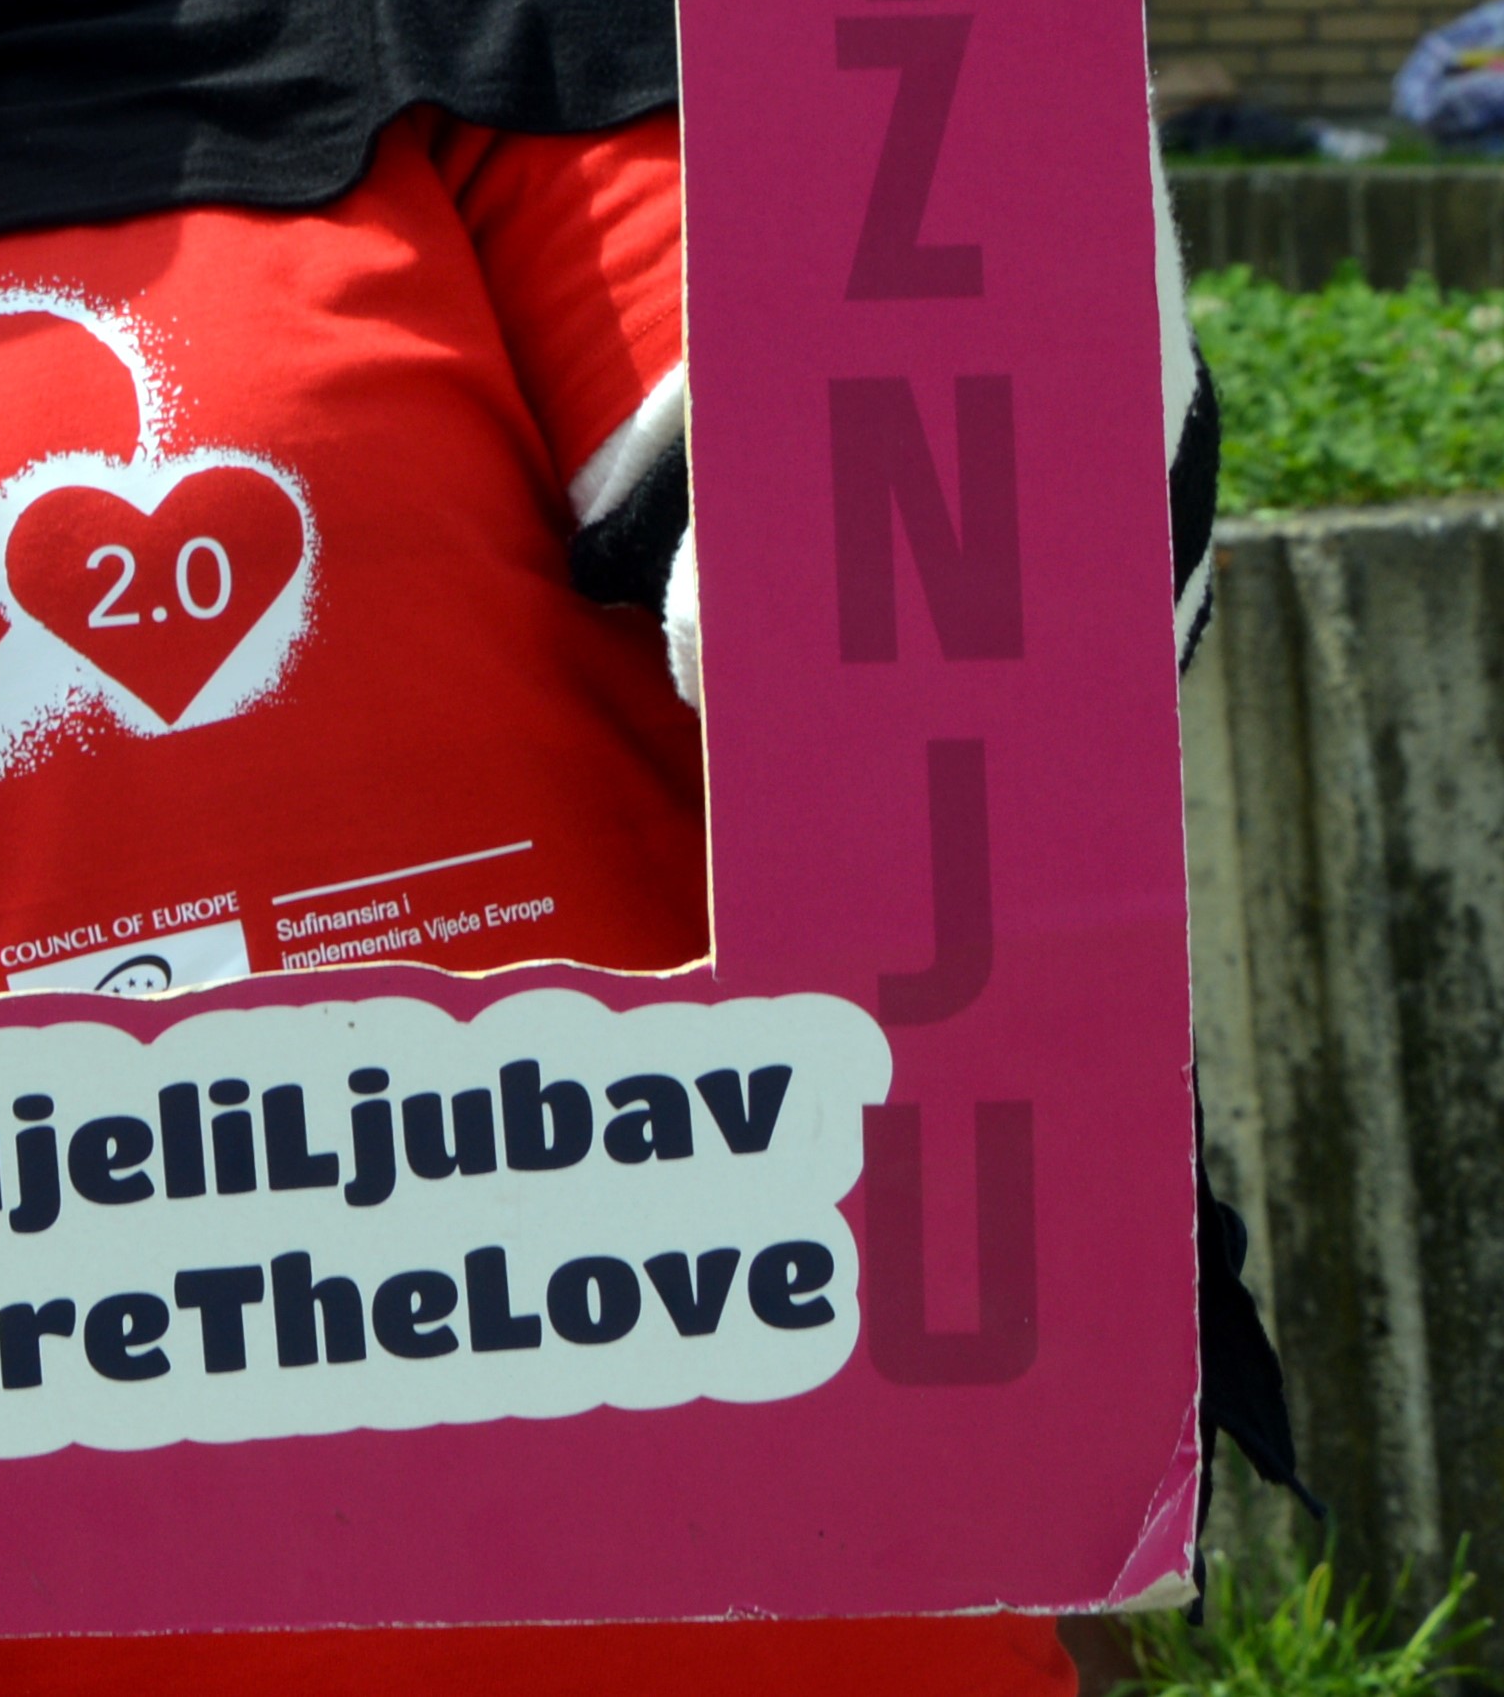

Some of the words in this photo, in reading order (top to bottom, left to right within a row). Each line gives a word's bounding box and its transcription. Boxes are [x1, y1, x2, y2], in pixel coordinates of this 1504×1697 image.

[86, 535, 233, 629] 2.0
[0, 924, 107, 967] COUNCIL
[113, 914, 144, 938] OF
[152, 891, 240, 930] EUROPE
[276, 899, 399, 942] Sufinansira
[403, 893, 411, 914] i
[281, 927, 422, 972] implementira
[424, 911, 481, 943] Vijeće
[485, 896, 555, 928] Evrope
